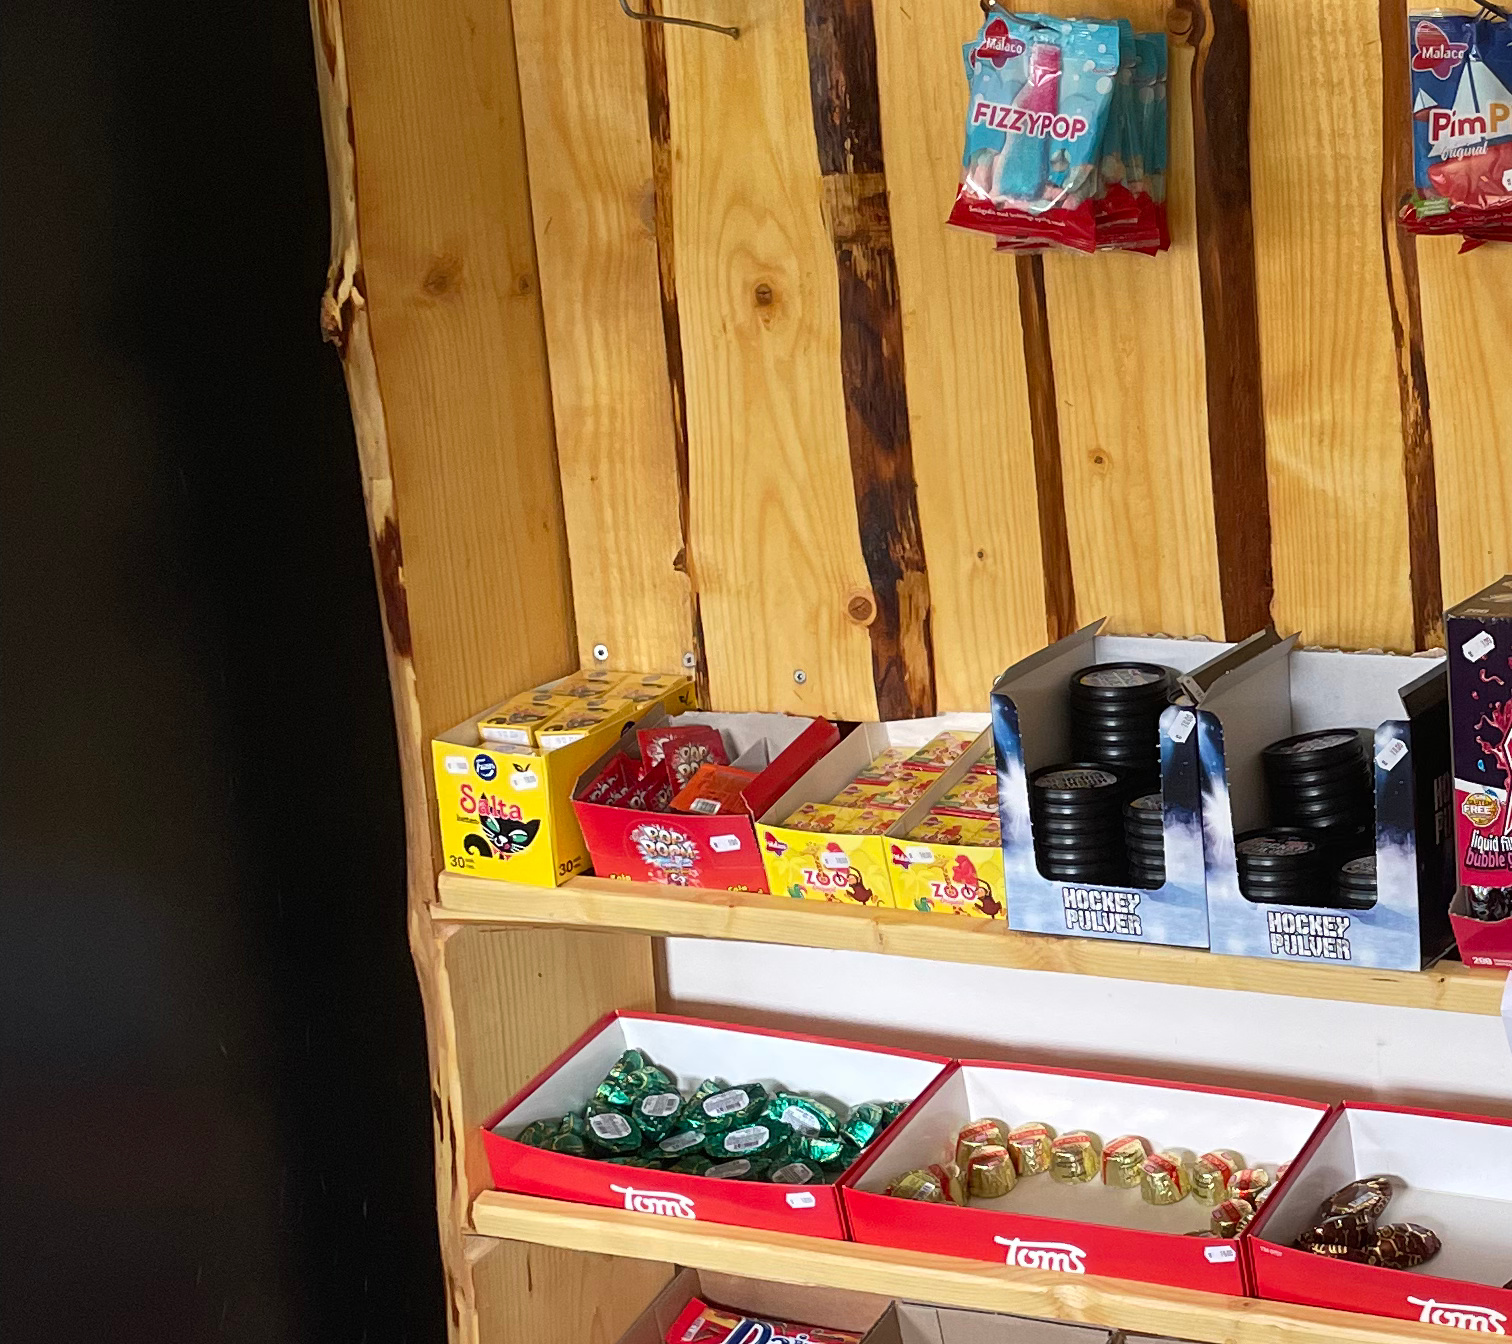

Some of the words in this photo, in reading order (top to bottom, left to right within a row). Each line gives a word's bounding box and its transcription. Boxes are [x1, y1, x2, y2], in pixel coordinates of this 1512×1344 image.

[985, 35, 1024, 56] Malaco
[1421, 45, 1466, 60] Malaco
[972, 100, 1088, 142] FIZZYPOP
[459, 783, 524, 821] Salta
[1463, 806, 1492, 815] FREE
[643, 825, 684, 844] POP
[1470, 829, 1500, 854] liquid
[449, 854, 466, 869] 30
[558, 859, 574, 877] 30
[1465, 847, 1507, 868] bubble
[803, 869, 849, 888] ZOO
[931, 882, 979, 900] ZOO
[1062, 886, 1142, 914] HOCKEY
[1064, 908, 1143, 936] PULVER
[1266, 911, 1351, 938] HOCKEY
[1269, 933, 1351, 961] PULVER
[610, 1183, 697, 1220] Toms
[994, 1235, 1087, 1274] Toms
[1407, 1295, 1507, 1336] Toms
